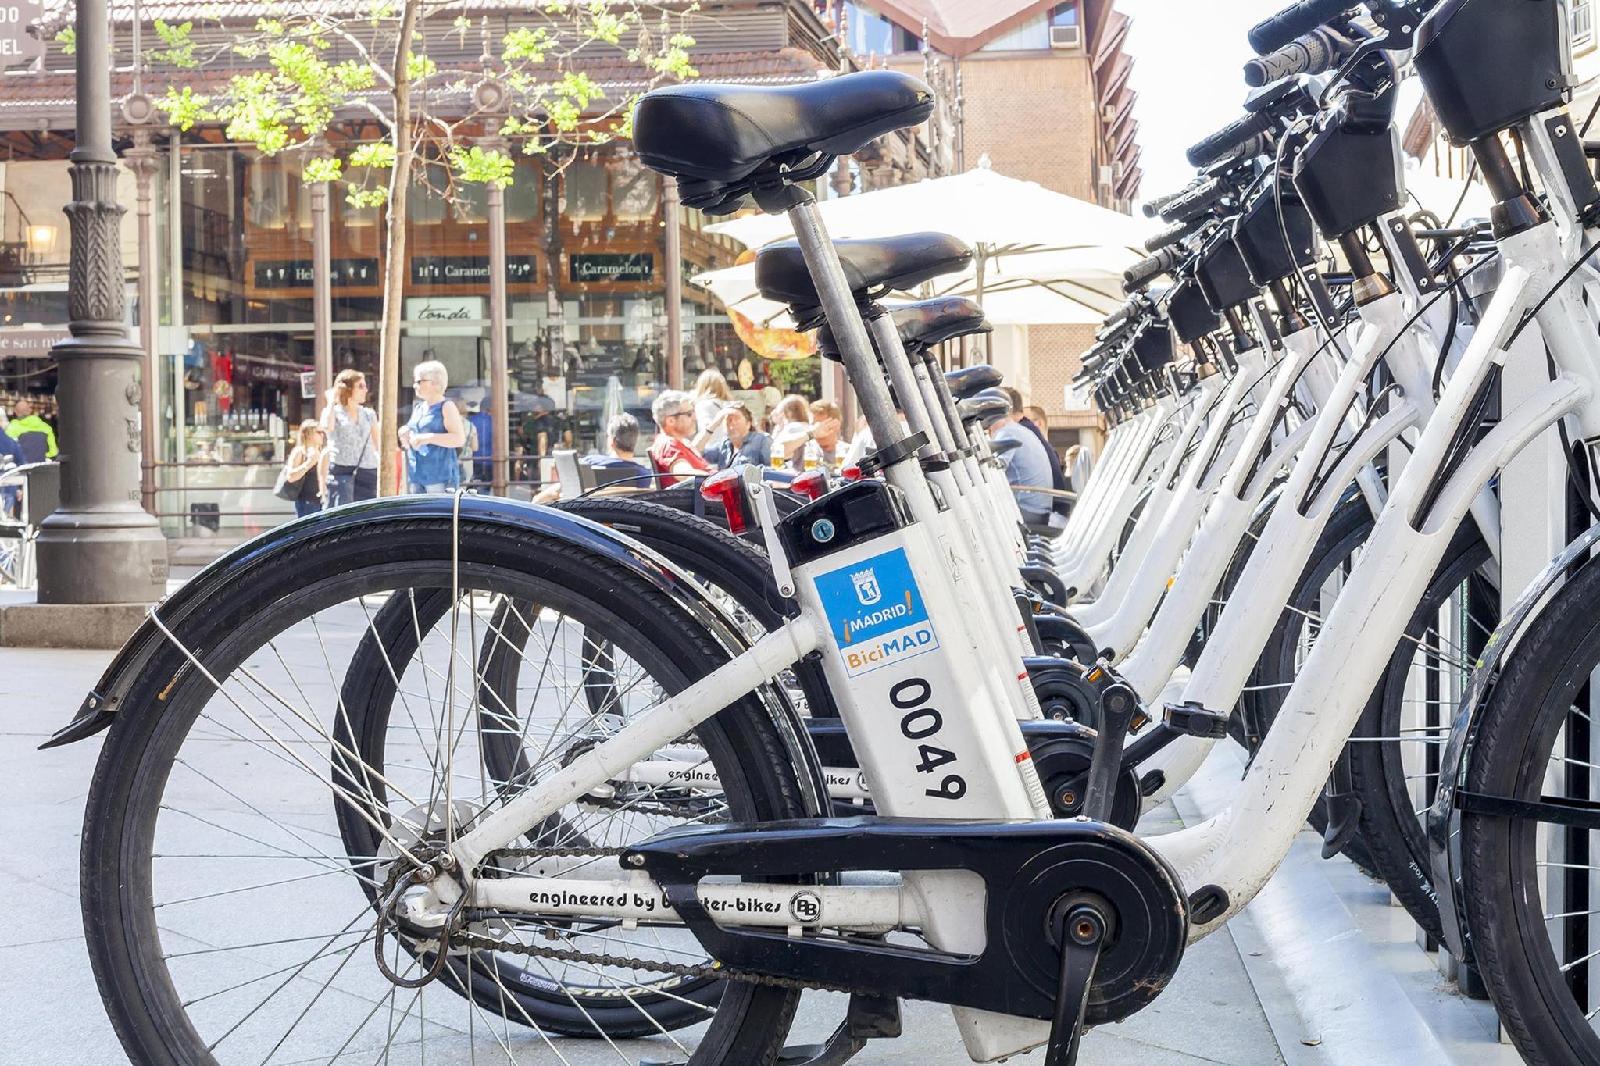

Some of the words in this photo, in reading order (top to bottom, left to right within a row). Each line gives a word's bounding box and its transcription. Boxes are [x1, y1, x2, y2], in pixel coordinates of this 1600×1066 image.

[583, 262, 642, 275] Caramelos
[847, 629, 931, 669] BiciMAD
[889, 677, 967, 800] 0049
[529, 891, 627, 908] engineered
[633, 893, 656, 912] by
